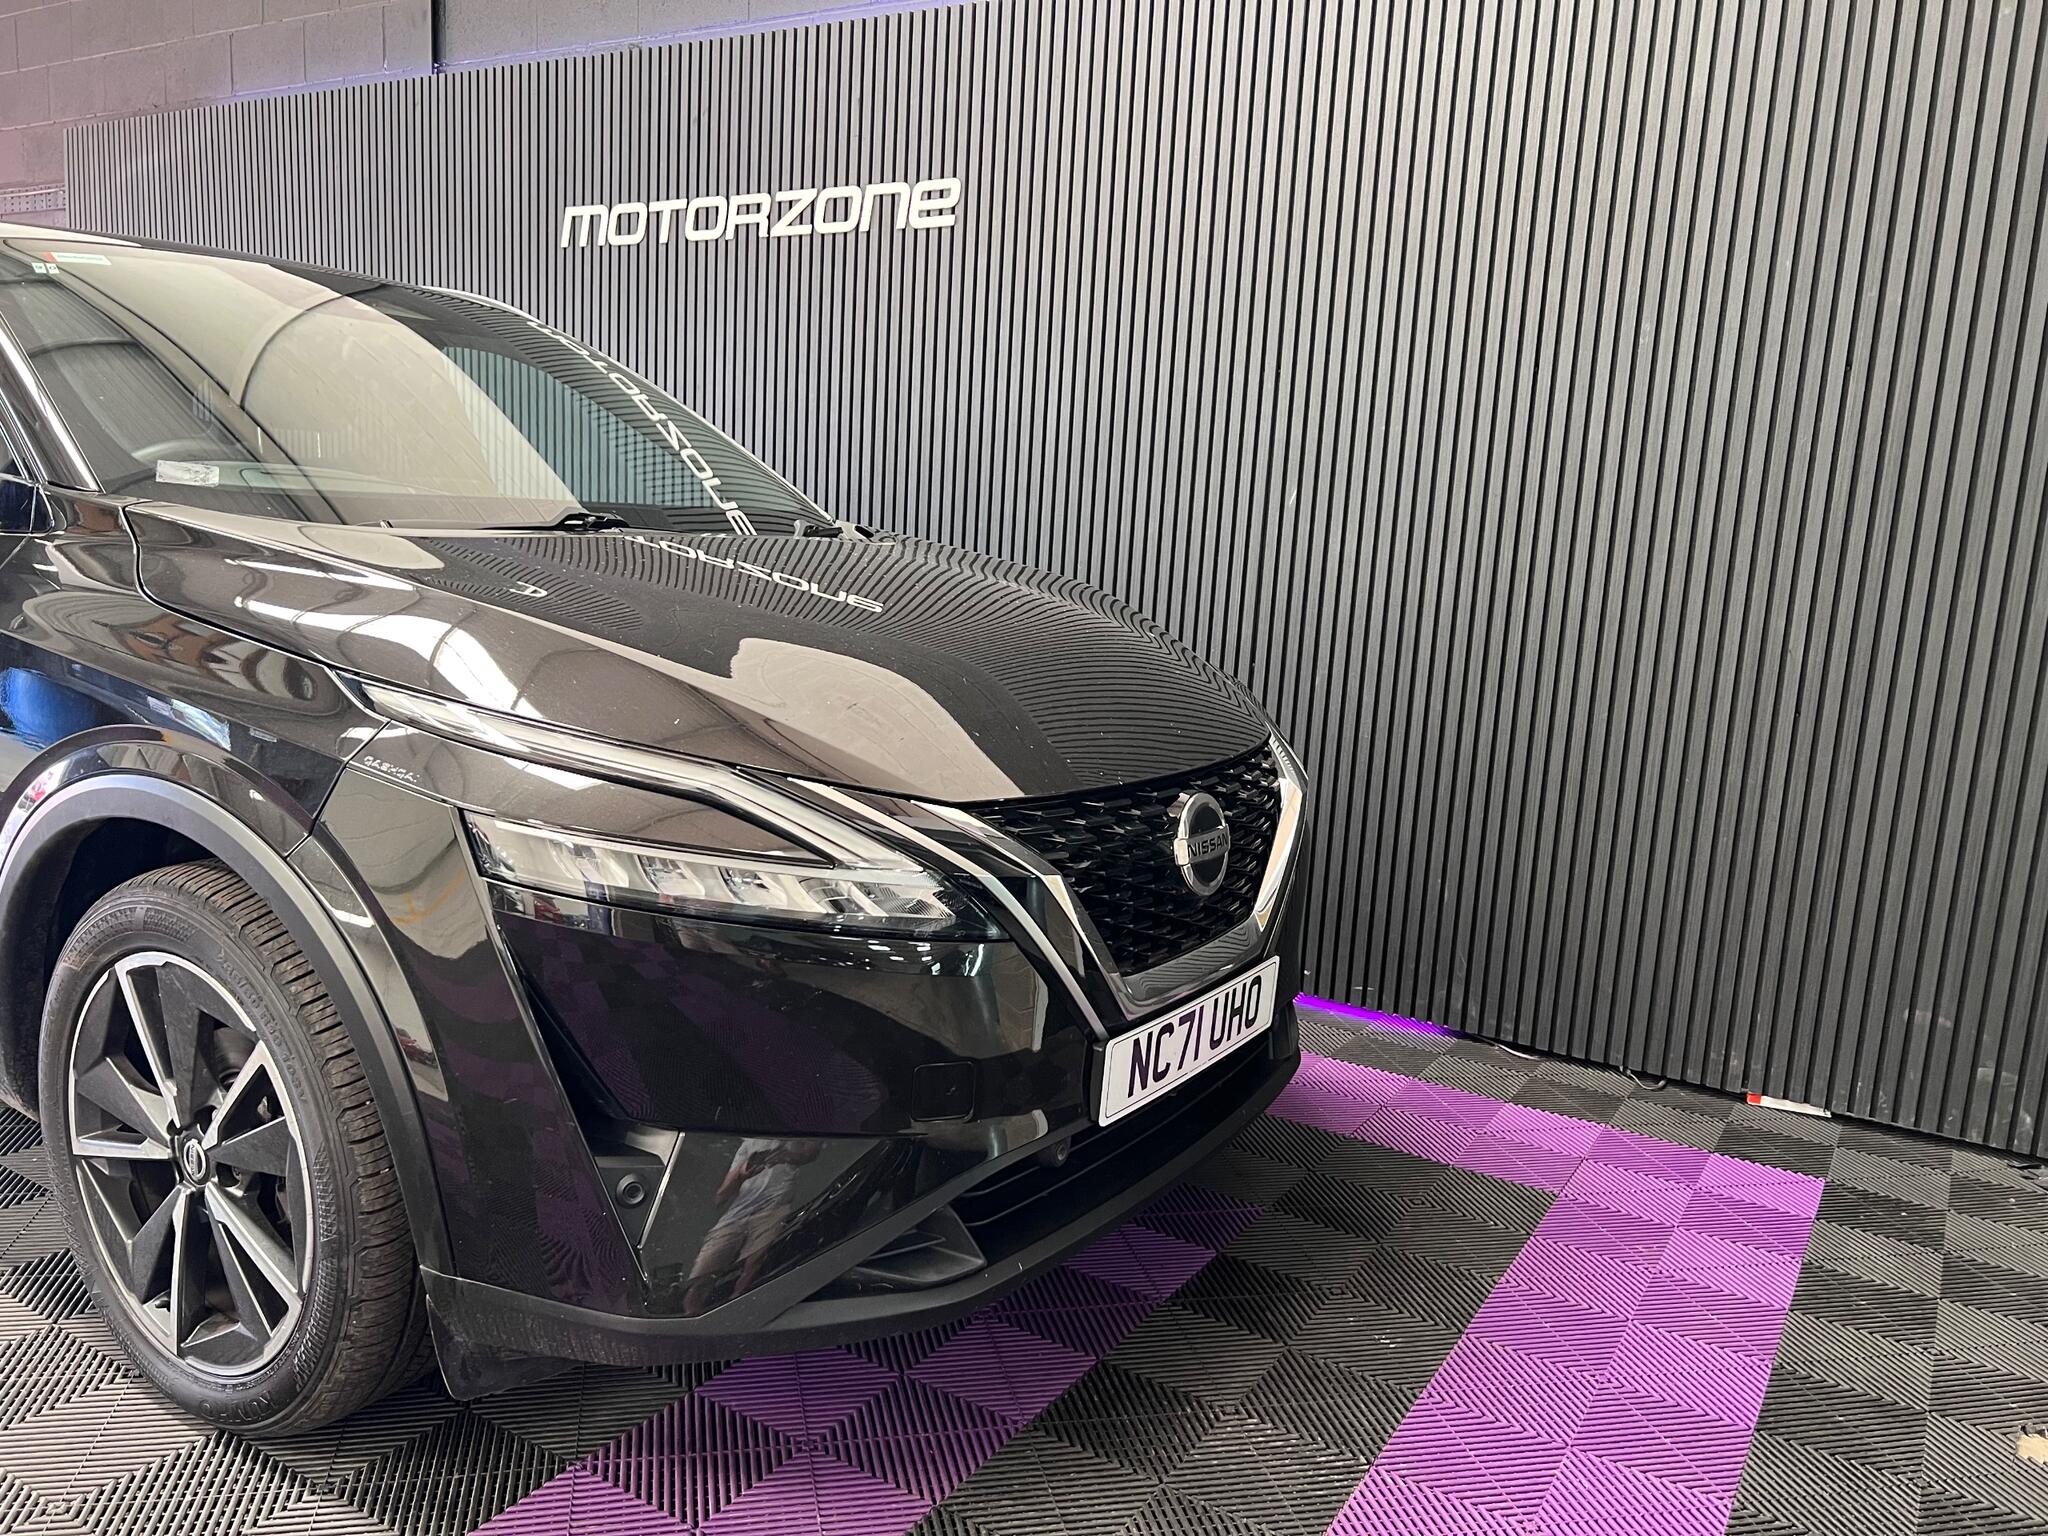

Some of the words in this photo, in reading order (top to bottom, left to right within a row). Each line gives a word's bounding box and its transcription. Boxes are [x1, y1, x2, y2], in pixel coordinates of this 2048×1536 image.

[1187, 831, 1229, 859] NISSAN
[1127, 1004, 1205, 1099] NC71
[1209, 974, 1262, 1051] UHO
